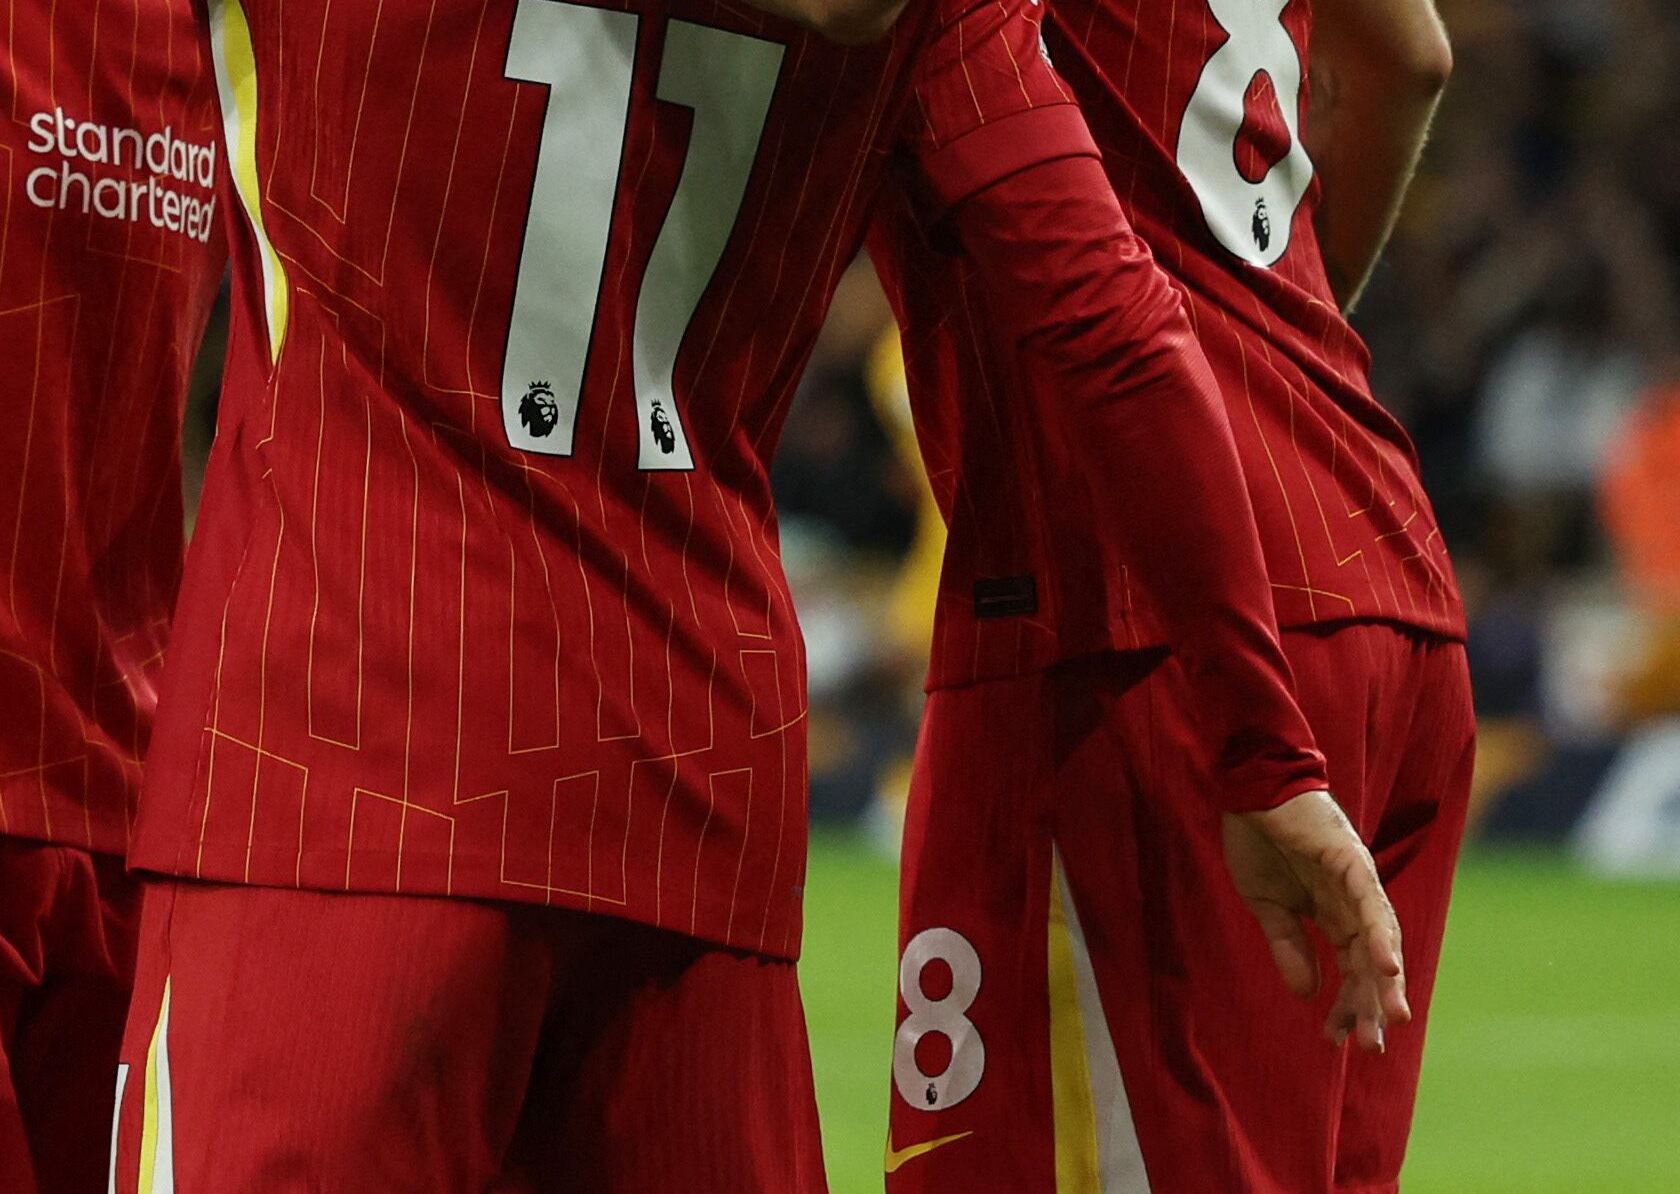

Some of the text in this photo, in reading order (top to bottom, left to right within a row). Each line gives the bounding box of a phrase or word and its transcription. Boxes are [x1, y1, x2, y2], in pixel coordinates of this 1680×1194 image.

[27, 106, 216, 189] standard
[26, 160, 216, 243] chartered
[893, 926, 985, 1112] 8
